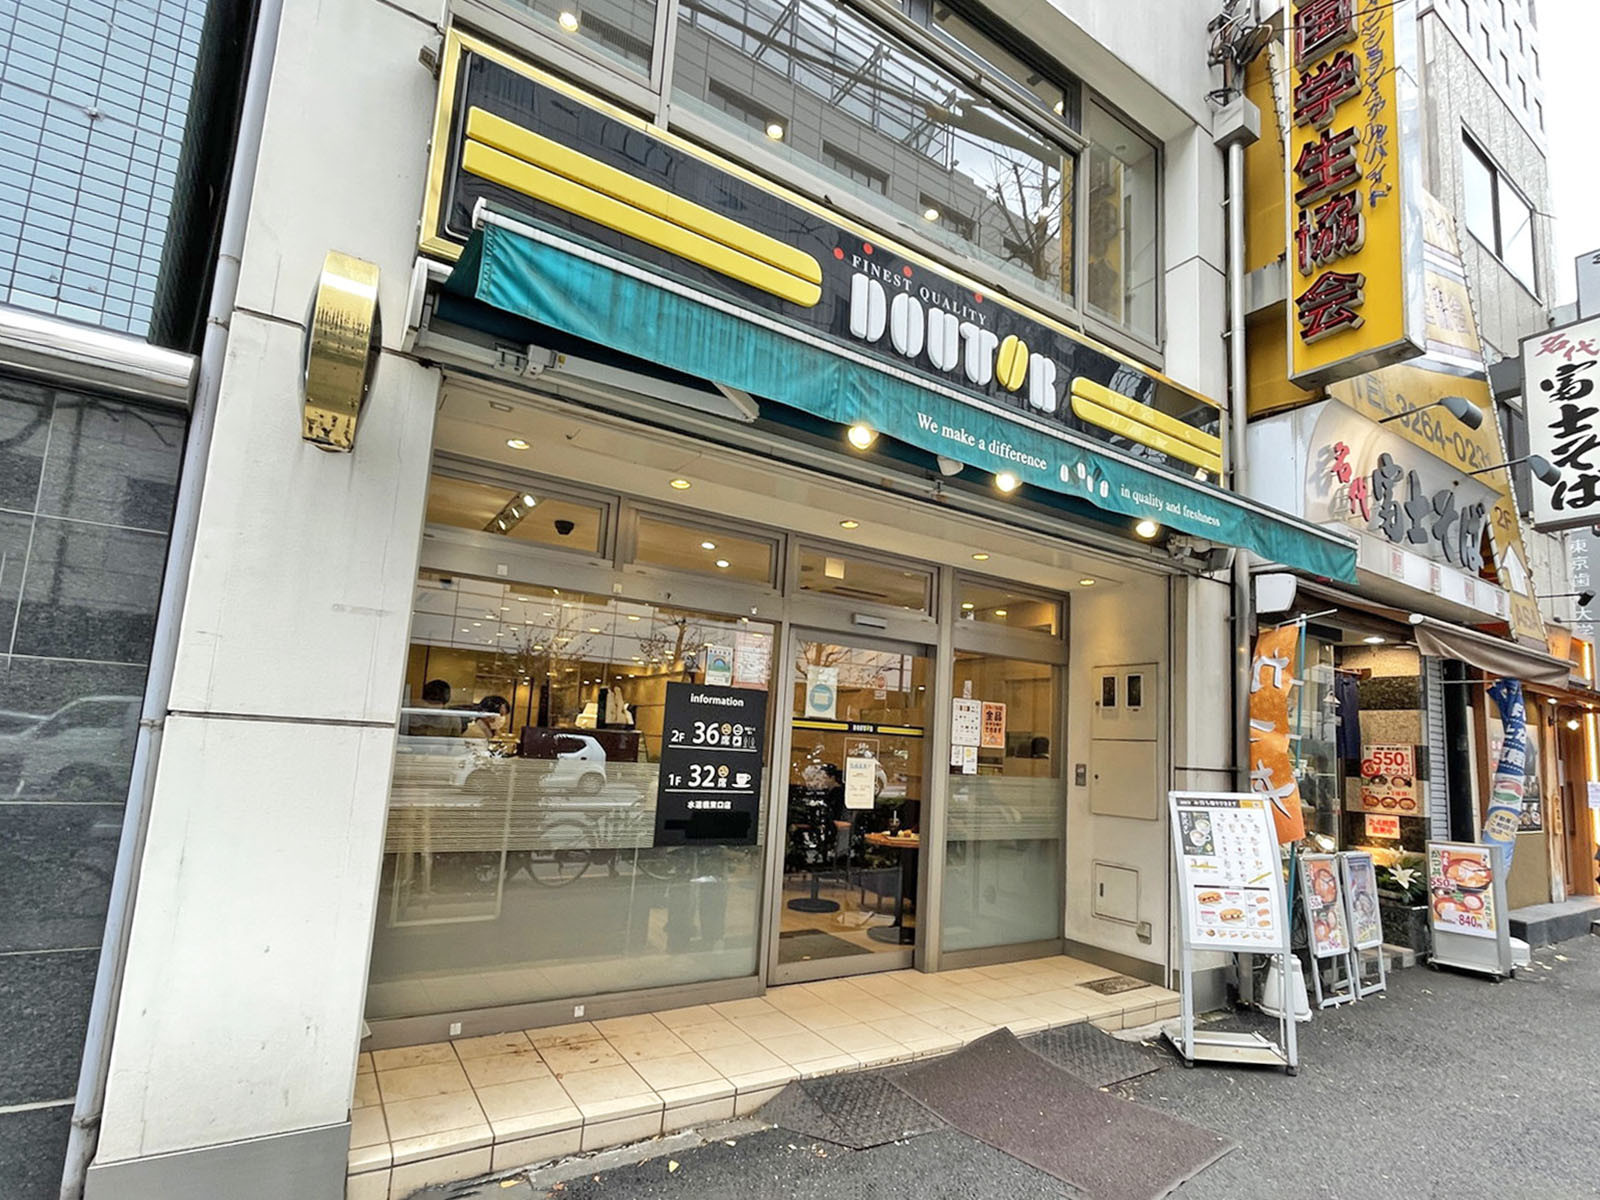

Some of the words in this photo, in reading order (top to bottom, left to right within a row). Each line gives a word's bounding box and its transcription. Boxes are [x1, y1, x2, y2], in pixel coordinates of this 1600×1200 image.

[852, 254, 913, 291] FINEST
[919, 286, 988, 326] QUALITY
[850, 272, 1057, 414] DOUTOR
[917, 411, 938, 433] We
[941, 425, 976, 446] make
[978, 439, 986, 451] a
[988, 440, 1048, 470] difference
[1121, 484, 1131, 498] in
[1132, 490, 1164, 511] quality
[1165, 502, 1181, 515] and
[1183, 505, 1221, 527] freshness
[1494, 506, 1513, 529] 2F
[1570, 539, 1595, 635] 東京歯大学
[671, 730, 685, 742] 2F
[692, 721, 720, 745] 36
[668, 773, 682, 786] 1F
[688, 764, 716, 787] 32
[1373, 751, 1405, 766] 550
